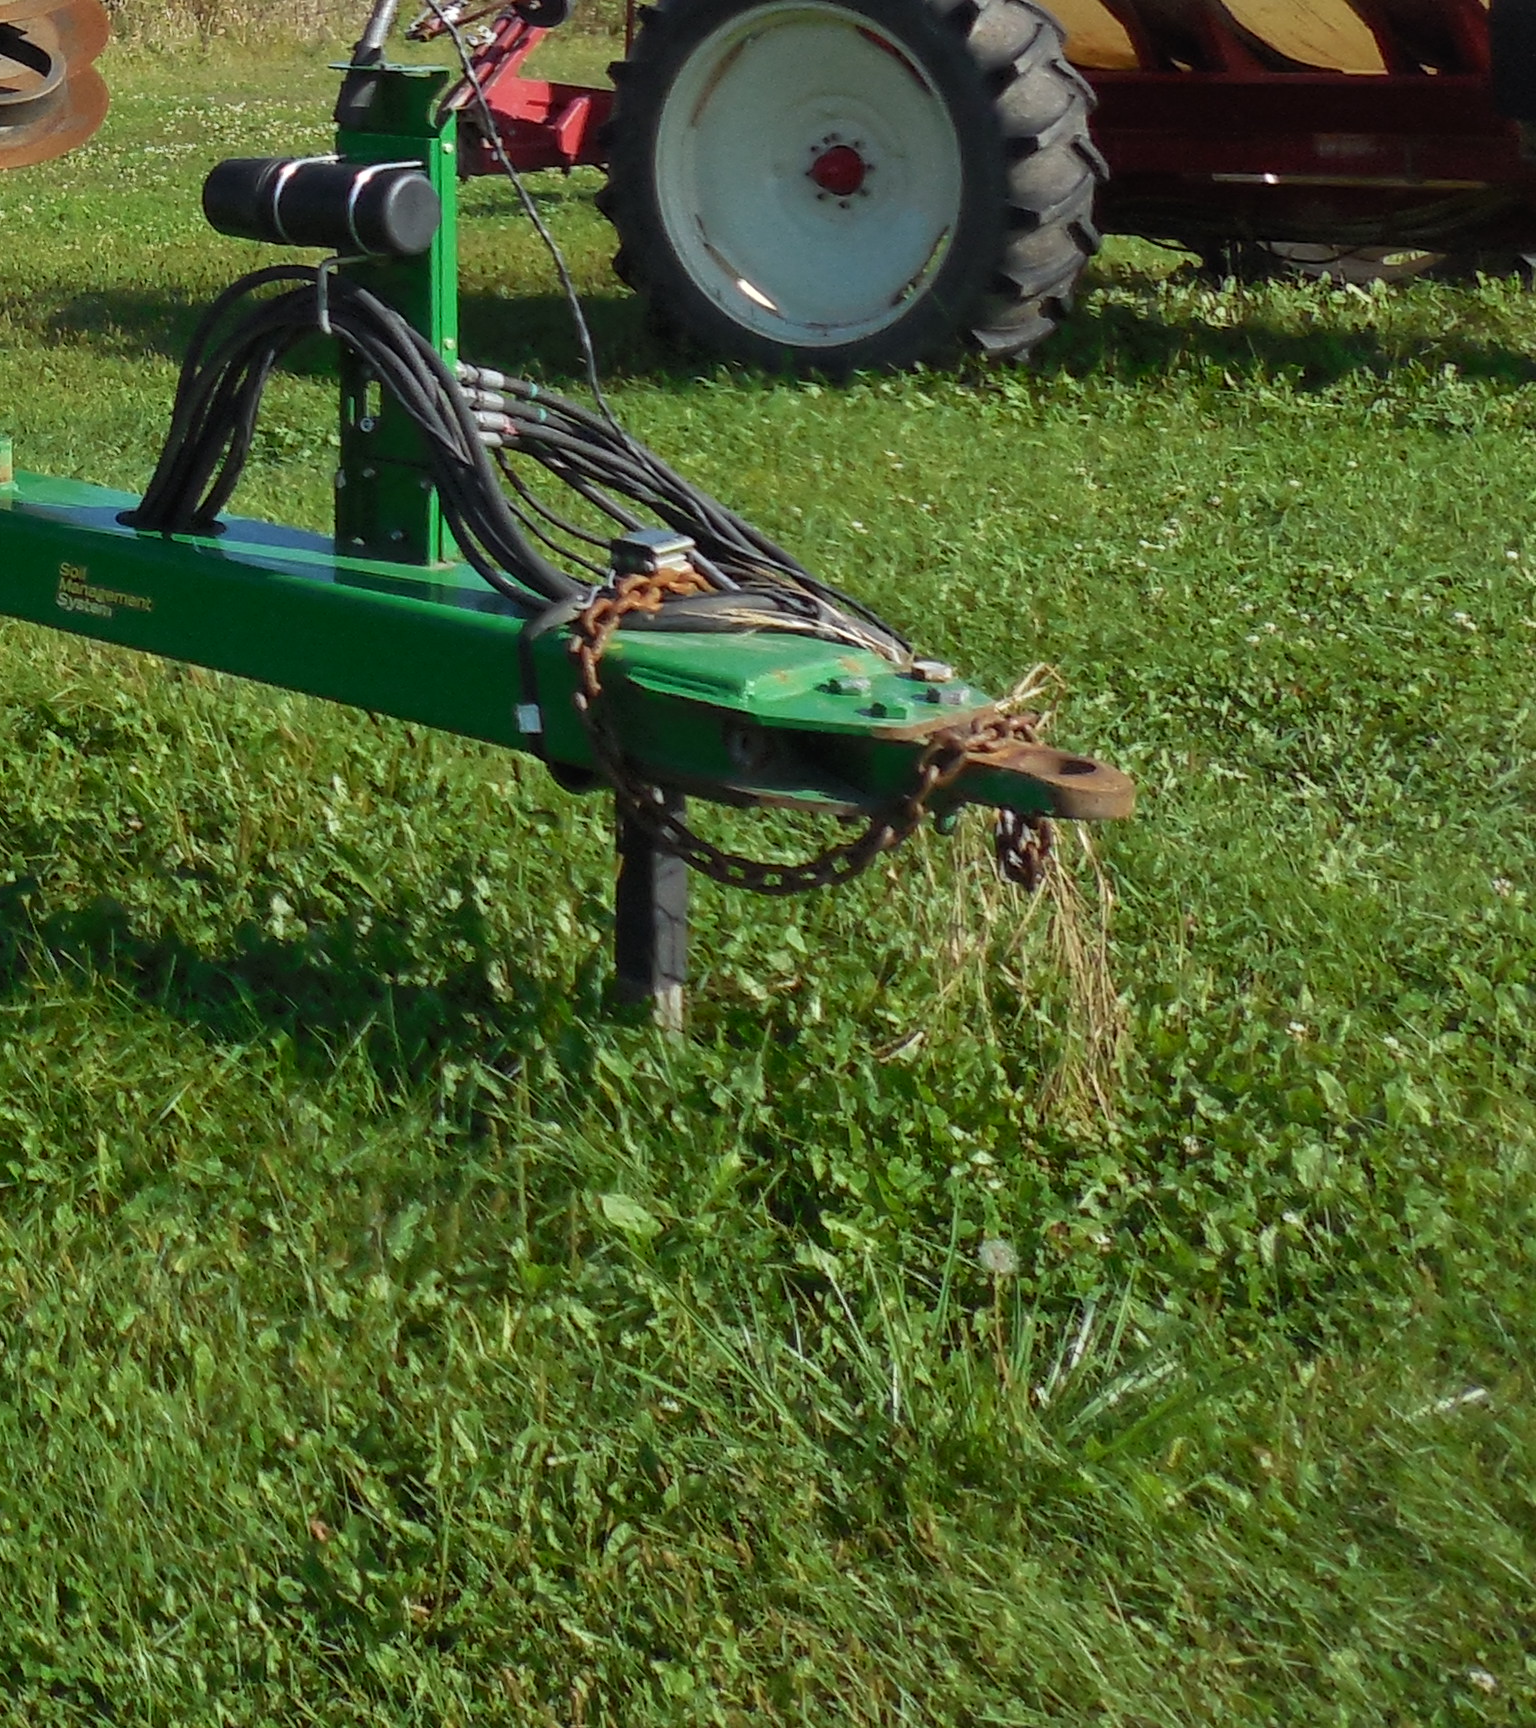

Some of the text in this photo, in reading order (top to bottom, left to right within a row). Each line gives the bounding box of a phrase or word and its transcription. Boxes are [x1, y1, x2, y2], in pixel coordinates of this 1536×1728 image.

[59, 561, 87, 581] Soil
[56, 592, 113, 617] System
[59, 577, 152, 612] Management
